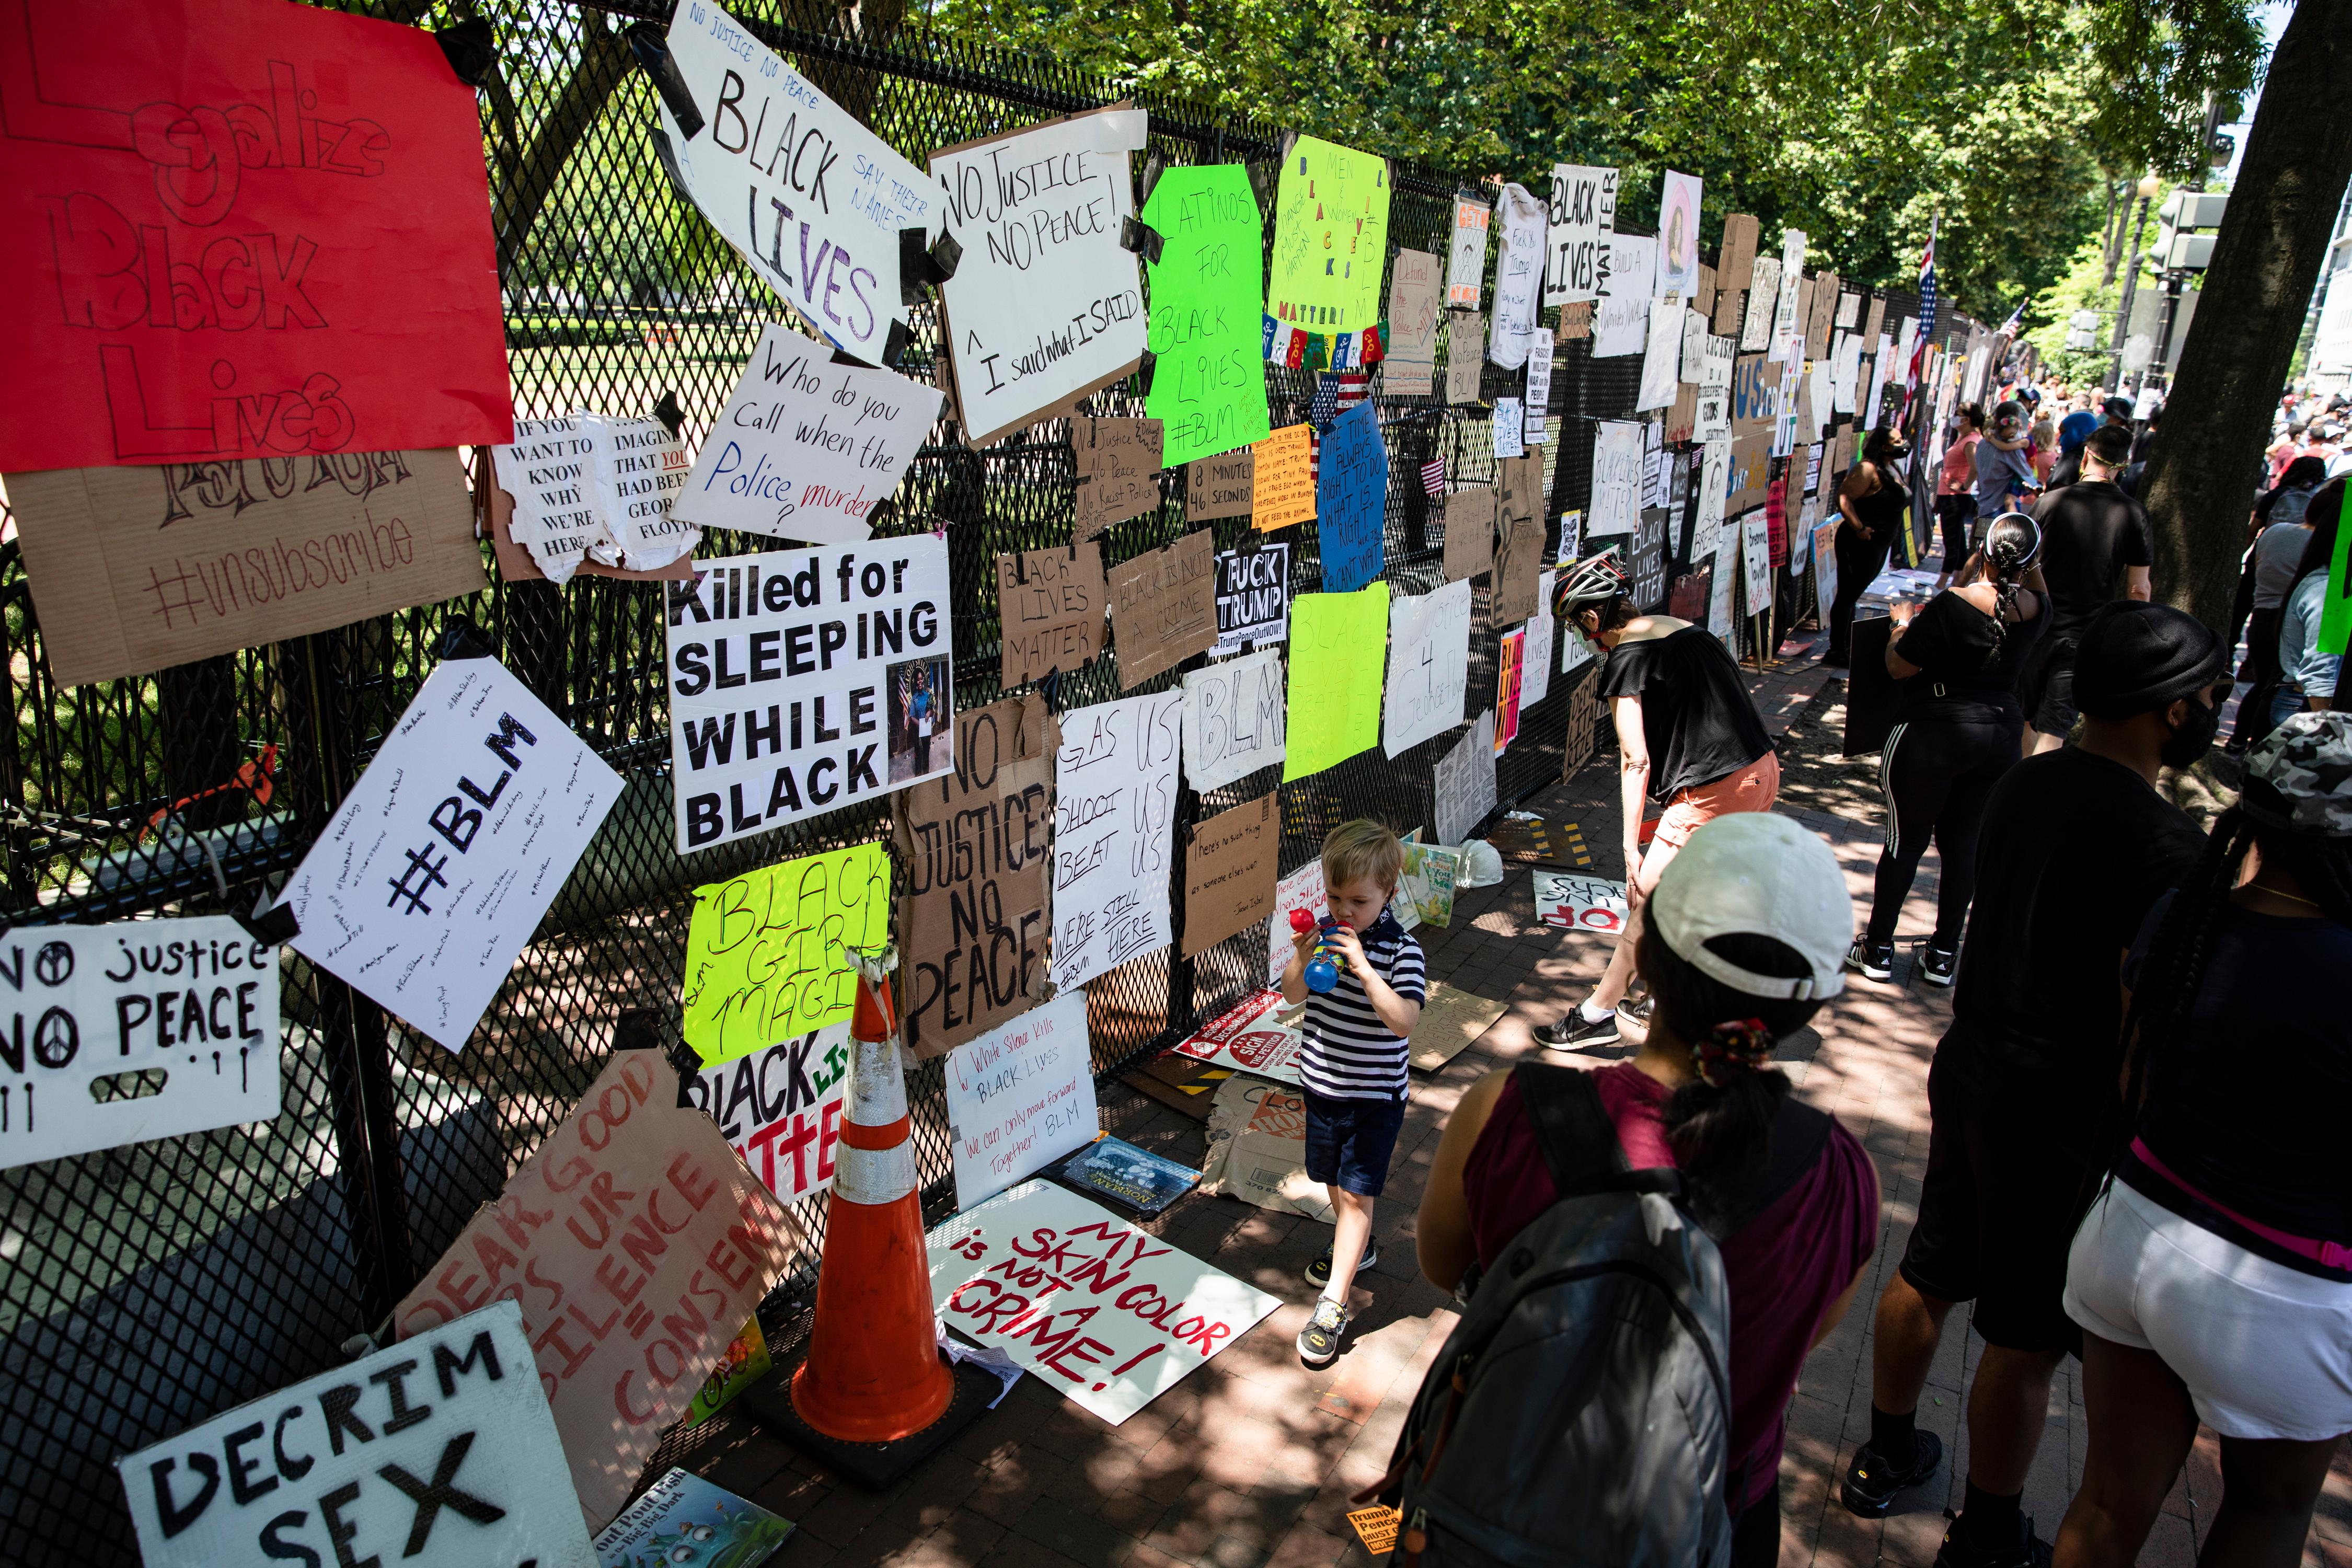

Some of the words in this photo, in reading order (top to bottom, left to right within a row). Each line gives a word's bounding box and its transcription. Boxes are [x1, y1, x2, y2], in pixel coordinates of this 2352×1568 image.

[689, 5, 706, 26] NO
[709, 16, 754, 63] JUSTICE
[759, 55, 778, 78] NO
[783, 74, 818, 111] PEACE
[713, 68, 839, 215] BLACK
[1327, 152, 1354, 180] MEN
[852, 154, 883, 188] SAY
[891, 179, 928, 218] THEIR
[1550, 176, 1596, 228] BLACK
[1325, 206, 1357, 225] WOMEN
[1595, 172, 1617, 297] MATTER
[750, 184, 877, 342] LIVES
[1195, 243, 1231, 285] FOR
[1398, 252, 1429, 283] Defund
[1546, 240, 1595, 295] LIVES
[1613, 249, 1634, 273] BUILD
[1634, 251, 1642, 273] A
[1449, 285, 1460, 302] MY
[1156, 306, 1230, 355] BLACK
[1392, 313, 1412, 333] Police
[1450, 319, 1463, 339] No
[1464, 314, 1484, 340] Justice
[1542, 333, 1548, 344] NO
[1450, 345, 1462, 366] No
[1463, 341, 1480, 363] Peace
[1532, 361, 1549, 373] MILITARY
[1535, 347, 1550, 358] FASCIST
[764, 340, 820, 395] Who
[832, 375, 856, 407] do
[854, 396, 900, 426] you
[1178, 349, 1248, 403] LIVES
[1454, 371, 1476, 397] BLM
[1530, 389, 1544, 400] PEOPLE
[99, 344, 355, 459] Lives
[516, 421, 535, 437] IF
[539, 417, 577, 434] YOU
[733, 402, 785, 434] Call
[795, 414, 854, 456] when
[859, 435, 894, 472] the
[1139, 421, 1160, 436] Defund
[1495, 426, 1520, 440] LIVES
[510, 441, 565, 463] WANT
[568, 438, 593, 455] TO
[614, 454, 656, 474] THAT
[661, 449, 690, 467] YOU
[1090, 454, 1107, 481] No
[1109, 454, 1138, 480] Peace
[1336, 436, 1372, 471] ALWAYS
[528, 463, 583, 486] KNOW
[704, 441, 791, 501] Police
[1195, 465, 1203, 487] 8
[1212, 463, 1252, 482] MINUTES
[1255, 475, 1271, 486] KNOWN
[1272, 472, 1281, 480] FOR
[1283, 468, 1295, 479] TINY
[1298, 467, 1311, 476] PAWS
[1322, 471, 1349, 504] RIGHT
[1354, 462, 1367, 486] TO
[1370, 453, 1381, 479] DO
[540, 486, 583, 508] WHY
[1083, 492, 1094, 514] No
[1099, 486, 1125, 508] Racist
[1190, 492, 1206, 513] 46
[1211, 486, 1251, 504] SECONDS
[541, 510, 595, 532] WE'RE
[1632, 517, 1663, 556] BLACK
[1694, 521, 1723, 549] BREATHE
[143, 509, 412, 629] #unsubscribe
[1004, 554, 1070, 590] BLACK
[1120, 574, 1165, 613] BLACK
[1165, 564, 1179, 588] IS
[1181, 548, 1211, 583] NOT
[1227, 551, 1278, 592] FUCK
[1637, 549, 1662, 577] LIVES
[668, 557, 821, 627] Killed
[836, 553, 909, 603] for
[1020, 585, 1089, 624] LIVES
[1216, 585, 1282, 630] TRUMP
[1133, 621, 1145, 645] A
[1157, 590, 1205, 635] CRIME
[1493, 591, 1538, 627] Encourage
[1531, 614, 1549, 639] TRANS
[674, 601, 938, 697] SLEEPING
[1010, 620, 1090, 674] MATTER
[1502, 636, 1523, 673] BLACK
[1526, 638, 1548, 664] LIVES
[1293, 658, 1355, 688] LIVES
[1421, 640, 1434, 693] 4
[1523, 664, 1546, 694] MATTER
[1293, 686, 1350, 715] DEATHS
[1498, 667, 1523, 704] LIVES
[682, 686, 877, 771] WHILE
[1493, 696, 1520, 745] MATTER
[942, 712, 999, 804] NO
[1288, 740, 1334, 764] TEARS
[686, 742, 880, 848] BLACK
[1056, 787, 1124, 837] SHOOT
[1134, 773, 1171, 835] US
[1437, 745, 1492, 829] THEIR
[387, 711, 538, 916] #BLM
[1057, 830, 1119, 891] BEAT
[1132, 831, 1161, 879] US
[1194, 826, 1219, 862] There's
[1222, 837, 1228, 847] no
[1230, 832, 1243, 843] such
[1245, 824, 1261, 839] thing
[1191, 886, 1200, 895] as
[1203, 874, 1227, 890] someone
[1228, 866, 1243, 879] else's
[1246, 861, 1258, 872] war
[1276, 881, 1294, 896] There
[1297, 869, 1315, 885] comes
[1432, 868, 1451, 878] You
[1433, 878, 1449, 889] Me
[1434, 861, 1451, 871] Just
[707, 850, 890, 956] BLACK
[949, 879, 1002, 948] NO
[906, 908, 1042, 1044] PEACE
[1061, 955, 1090, 990] #BLM
[970, 1042, 1000, 1074] White
[1004, 1031, 1029, 1055] Silence
[1032, 1017, 1054, 1041] Kills
[1240, 1036, 1266, 1056] SIGN
[1250, 1054, 1263, 1065] THE
[1259, 1034, 1283, 1060] PETITION
[976, 1065, 1023, 1104] BLACK
[1025, 1046, 1059, 1077] LIVES
[965, 1136, 981, 1159] We
[984, 1127, 1000, 1149] can
[1005, 1110, 1027, 1136] only
[1027, 1099, 1046, 1119] move
[1047, 1076, 1076, 1106] forward
[1093, 1178, 1151, 1204] NORMAN
[565, 1171, 636, 1250] UR
[1064, 1220, 1173, 1272] MY
[950, 1228, 989, 1262] is
[988, 1258, 1075, 1299] NOT
[1059, 1305, 1102, 1328] A
[1011, 1227, 1132, 1295] SKIN
[1114, 1283, 1231, 1356] COLOR
[149, 1331, 505, 1540] DECRIM
[258, 1431, 506, 1568] SEX
[1359, 1517, 1400, 1531] Pence
